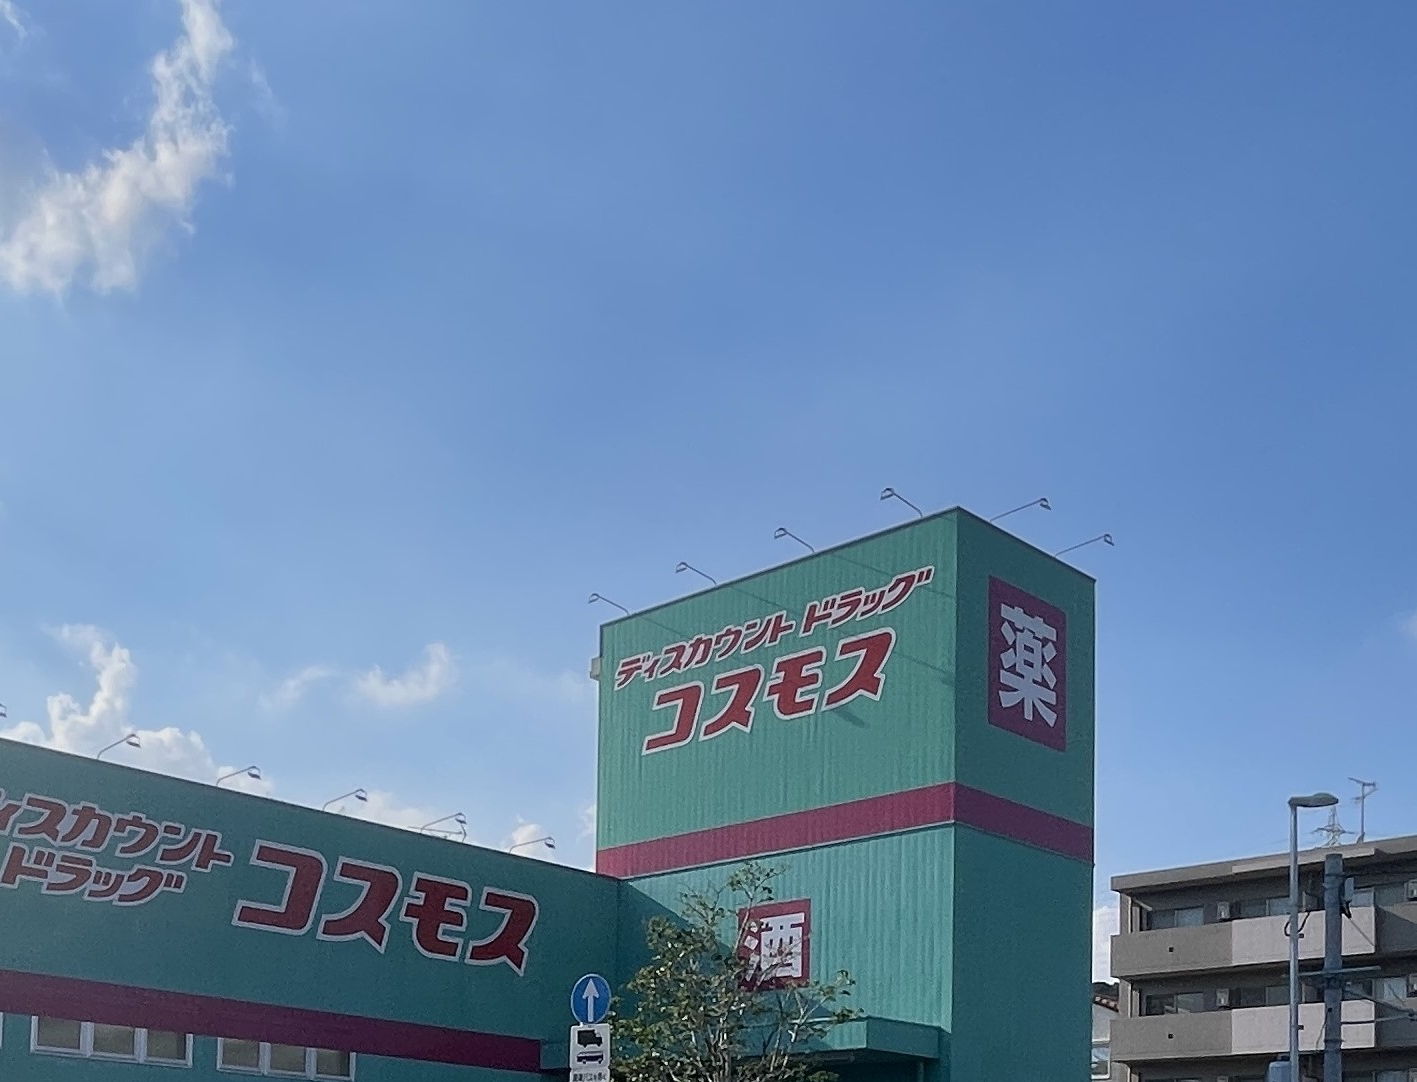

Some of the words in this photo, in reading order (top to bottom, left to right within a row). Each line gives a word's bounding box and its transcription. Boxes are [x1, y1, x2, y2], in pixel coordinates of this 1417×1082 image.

[614, 611, 796, 691] ディスカウント
[799, 566, 935, 636] ドラッグ
[998, 603, 1058, 728] 薬
[641, 627, 896, 756] コスモス
[231, 839, 540, 976] コスモス
[743, 911, 805, 982] 酒
